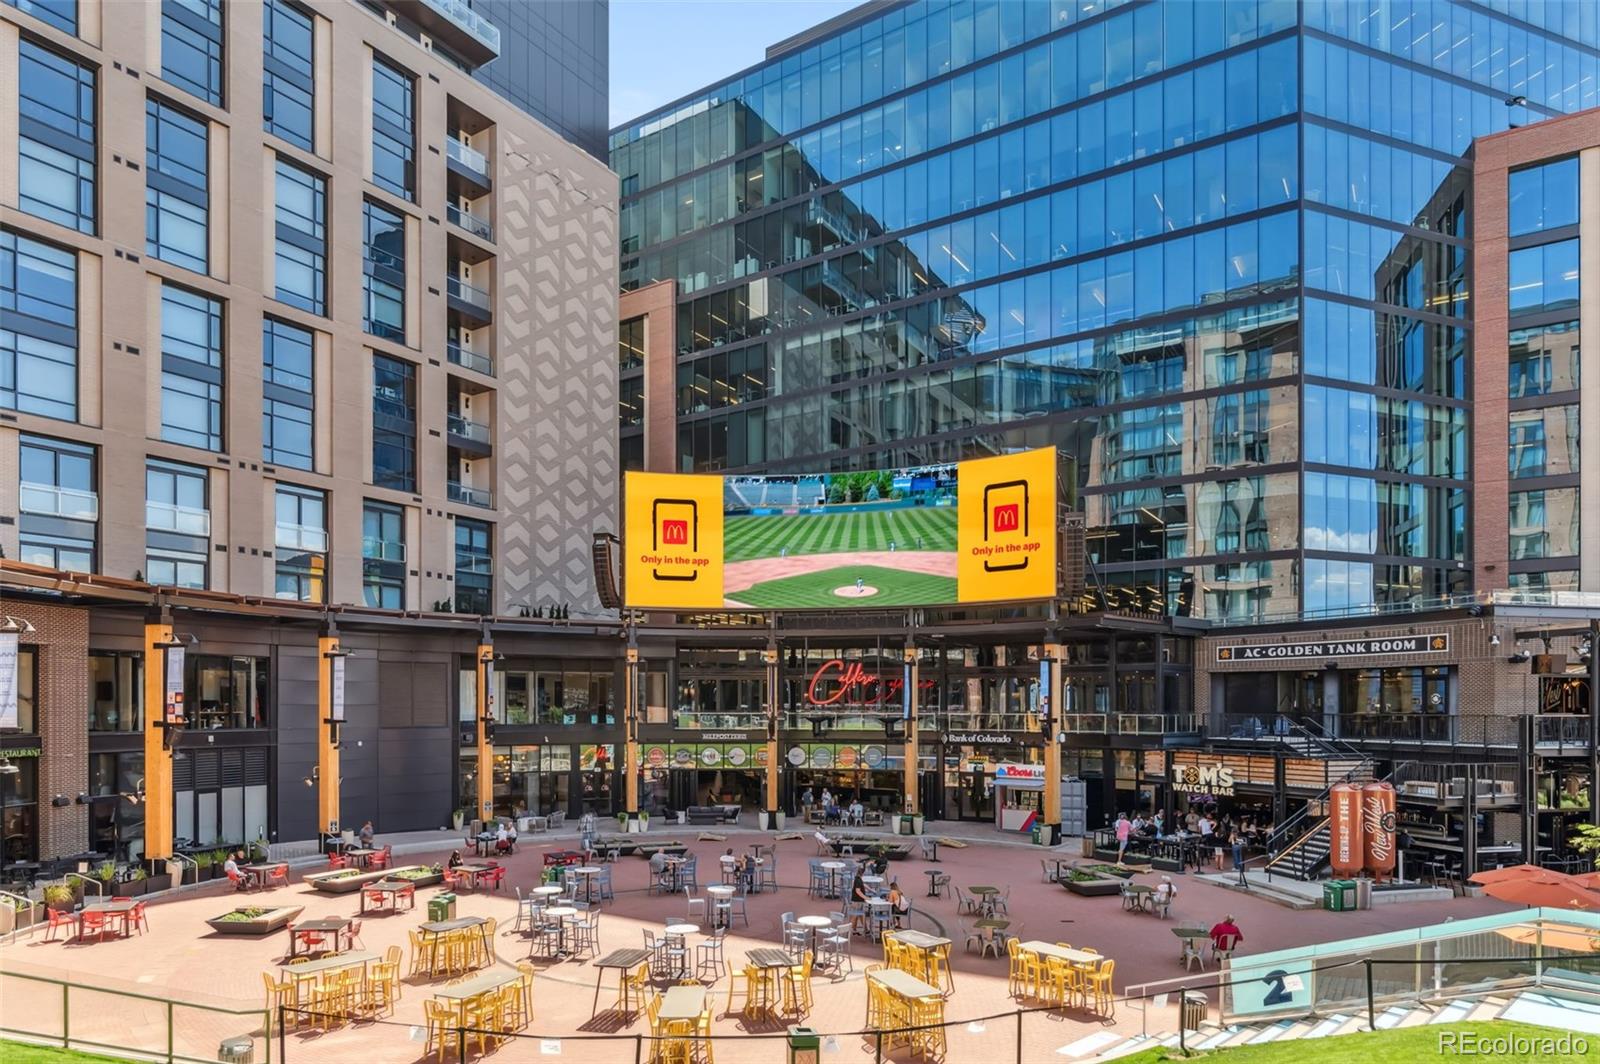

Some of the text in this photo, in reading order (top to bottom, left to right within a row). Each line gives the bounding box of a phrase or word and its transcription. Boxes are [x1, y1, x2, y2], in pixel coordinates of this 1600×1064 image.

[972, 542, 1041, 557] Only in the app
[641, 555, 709, 567] Only in the app
[1327, 642, 1367, 654] TANK
[1370, 639, 1416, 652] ROOM
[949, 734, 1012, 743] Bank of Colorado
[0, 748, 41, 758] ESTAURANT
[1171, 782, 1235, 797] WATCH BAR
[1339, 797, 1350, 822] THE
[1371, 831, 1392, 861] New
[1262, 969, 1293, 1007] 2
